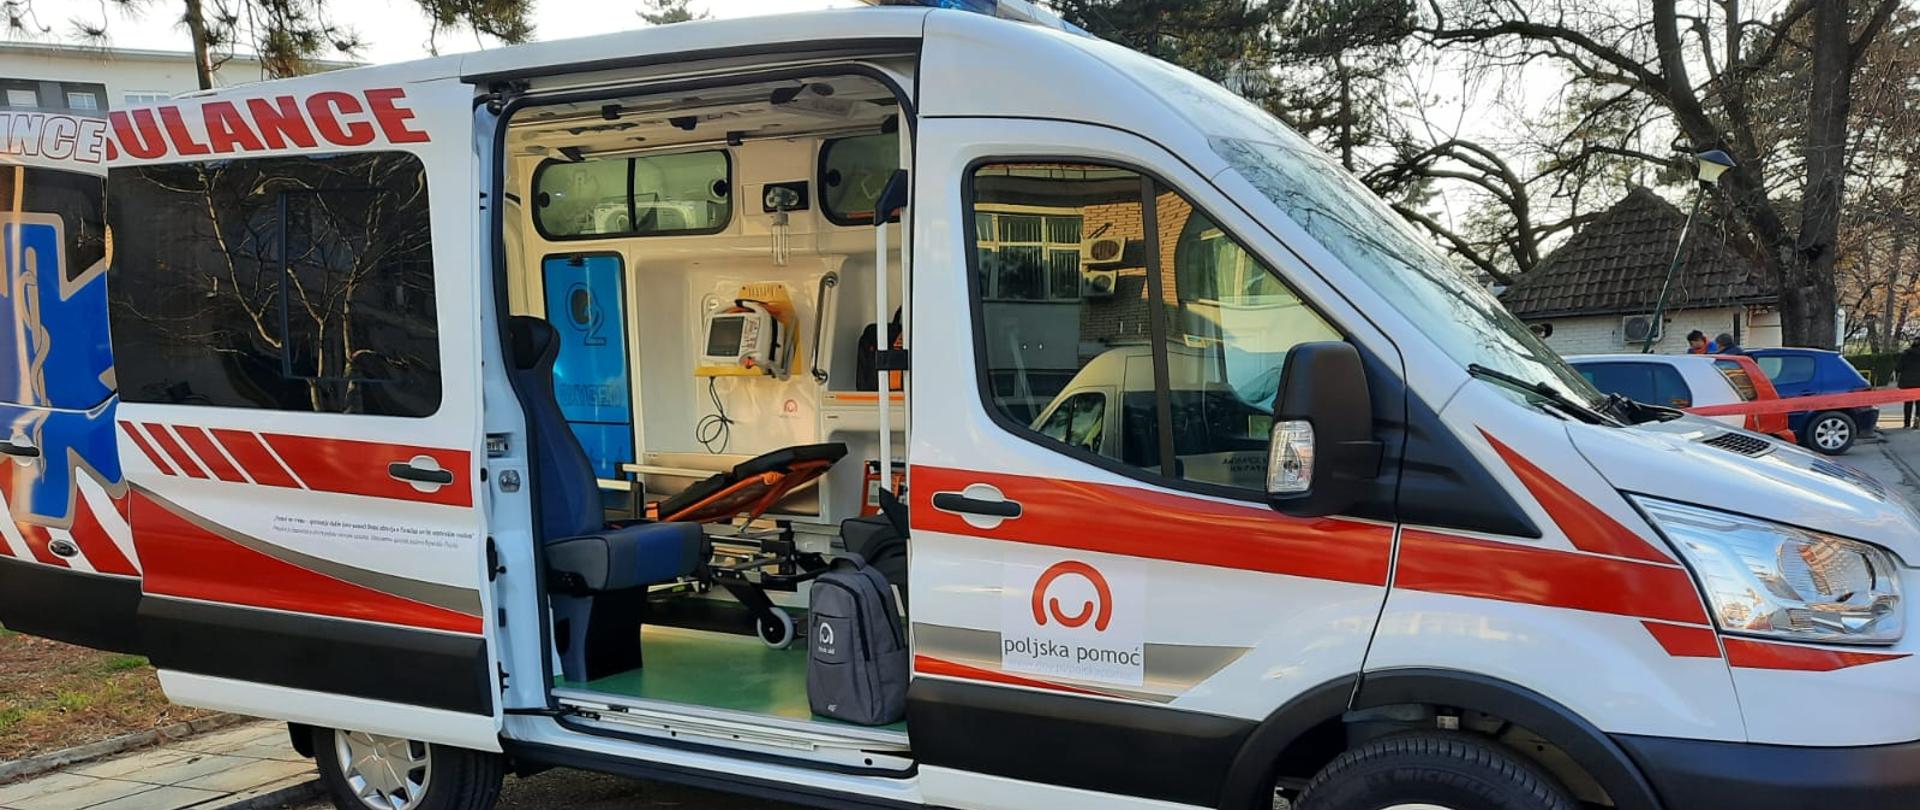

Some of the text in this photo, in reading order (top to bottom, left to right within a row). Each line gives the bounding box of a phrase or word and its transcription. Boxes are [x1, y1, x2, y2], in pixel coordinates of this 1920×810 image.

[0, 113, 107, 163] NCE
[106, 88, 431, 160] ULANCE
[1004, 637, 1141, 667] poljska pomoć
